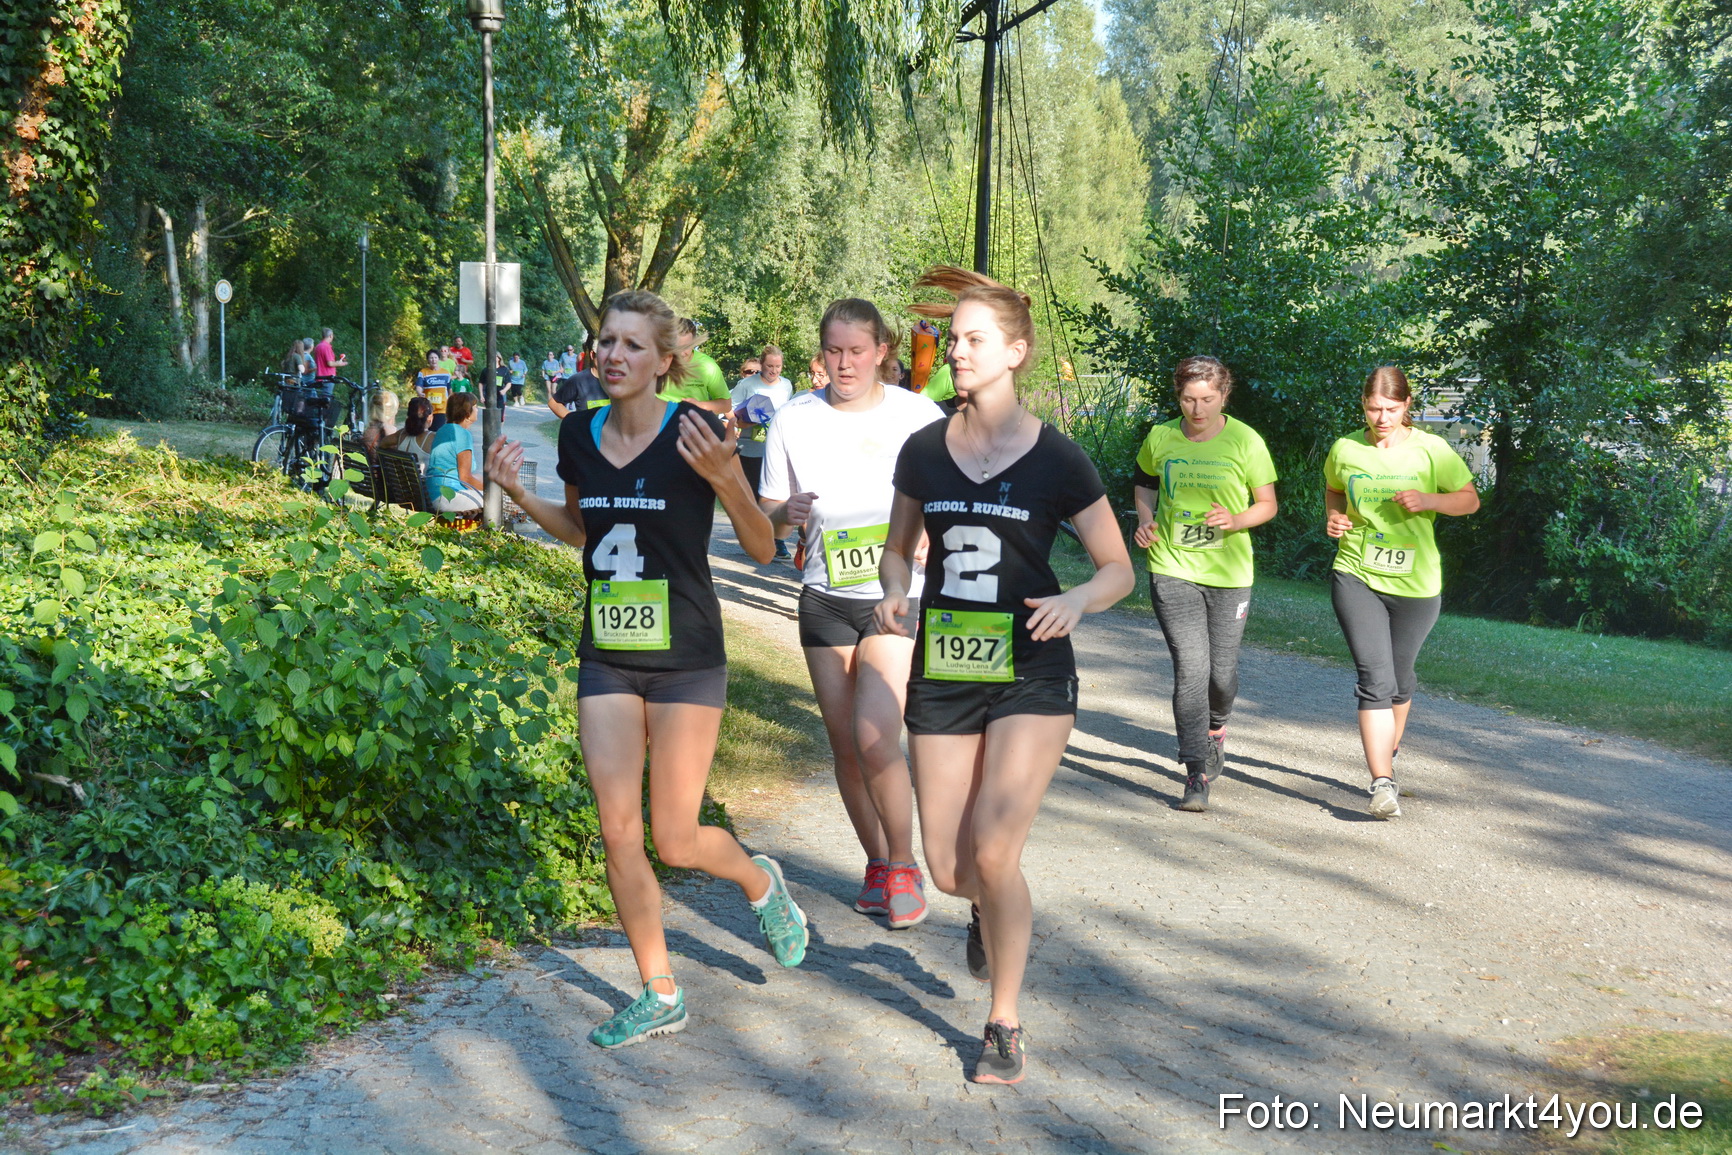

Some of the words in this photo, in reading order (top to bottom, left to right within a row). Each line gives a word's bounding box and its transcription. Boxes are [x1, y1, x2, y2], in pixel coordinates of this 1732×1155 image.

[1191, 459, 1233, 467] Zahnarztpraxis
[579, 497, 610, 508] CHOOL
[613, 496, 666, 510] RUNERS
[924, 500, 968, 514] SCHOOL
[972, 502, 1030, 522] RUNERS
[1183, 524, 1215, 541] 715
[592, 523, 645, 582] 4
[1374, 546, 1406, 565] 719
[838, 567, 874, 577] Windgassen
[940, 525, 1001, 603] 2
[598, 605, 655, 629] 1928
[603, 630, 628, 638] Bruckner
[629, 630, 649, 638] Maria
[935, 635, 1000, 662] 1927
[945, 661, 971, 670] Ludwig
[972, 662, 989, 670] Lena
